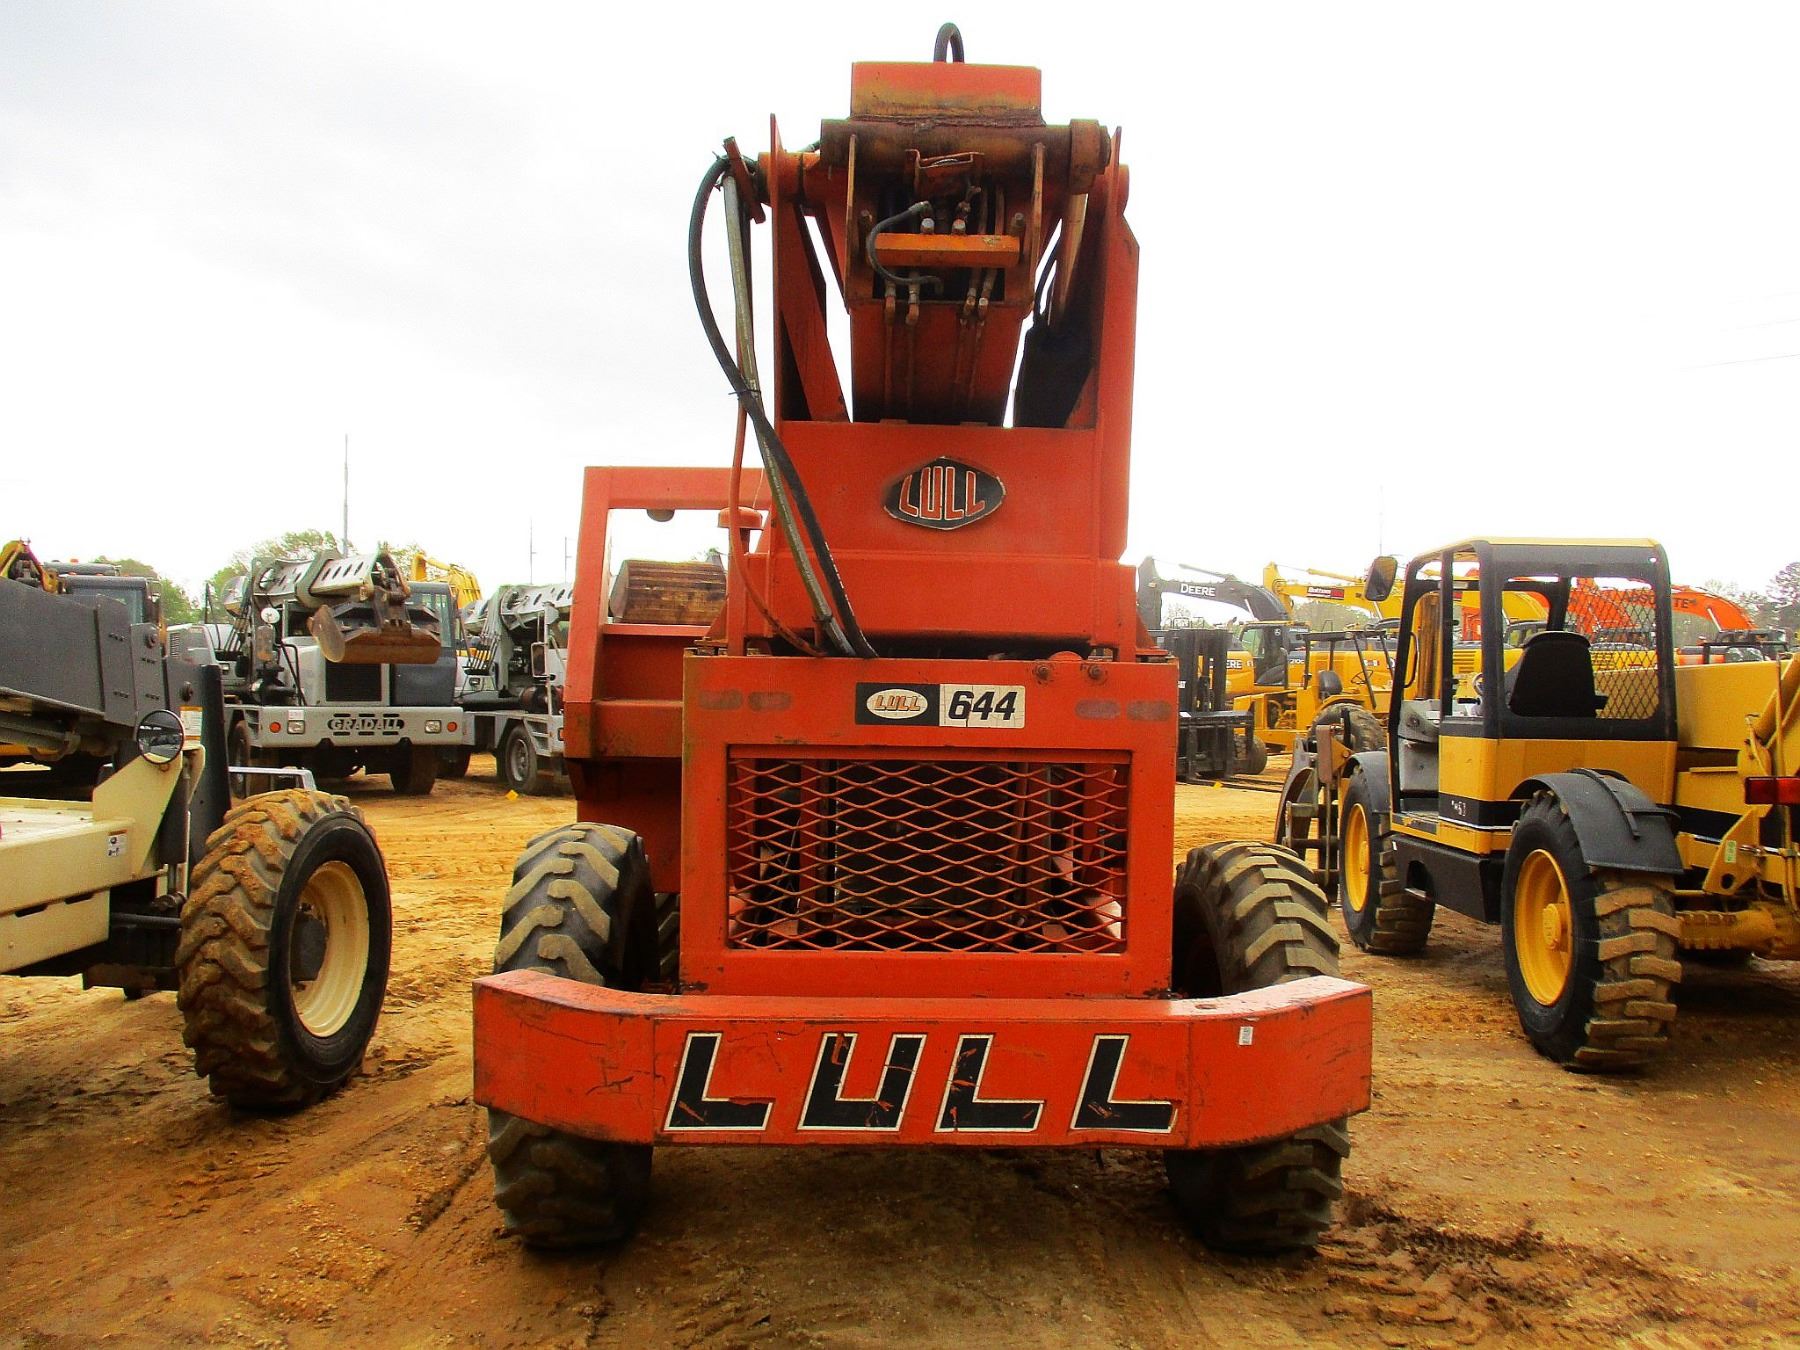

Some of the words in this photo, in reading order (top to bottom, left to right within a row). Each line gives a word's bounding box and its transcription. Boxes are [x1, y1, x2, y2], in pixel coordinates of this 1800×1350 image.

[899, 466, 985, 520] LULL
[1180, 583, 1216, 597] DEERE
[873, 694, 921, 712] LULL
[948, 690, 1018, 721] 644
[330, 718, 401, 731] GRADALL
[664, 1030, 1181, 1134] LULL
